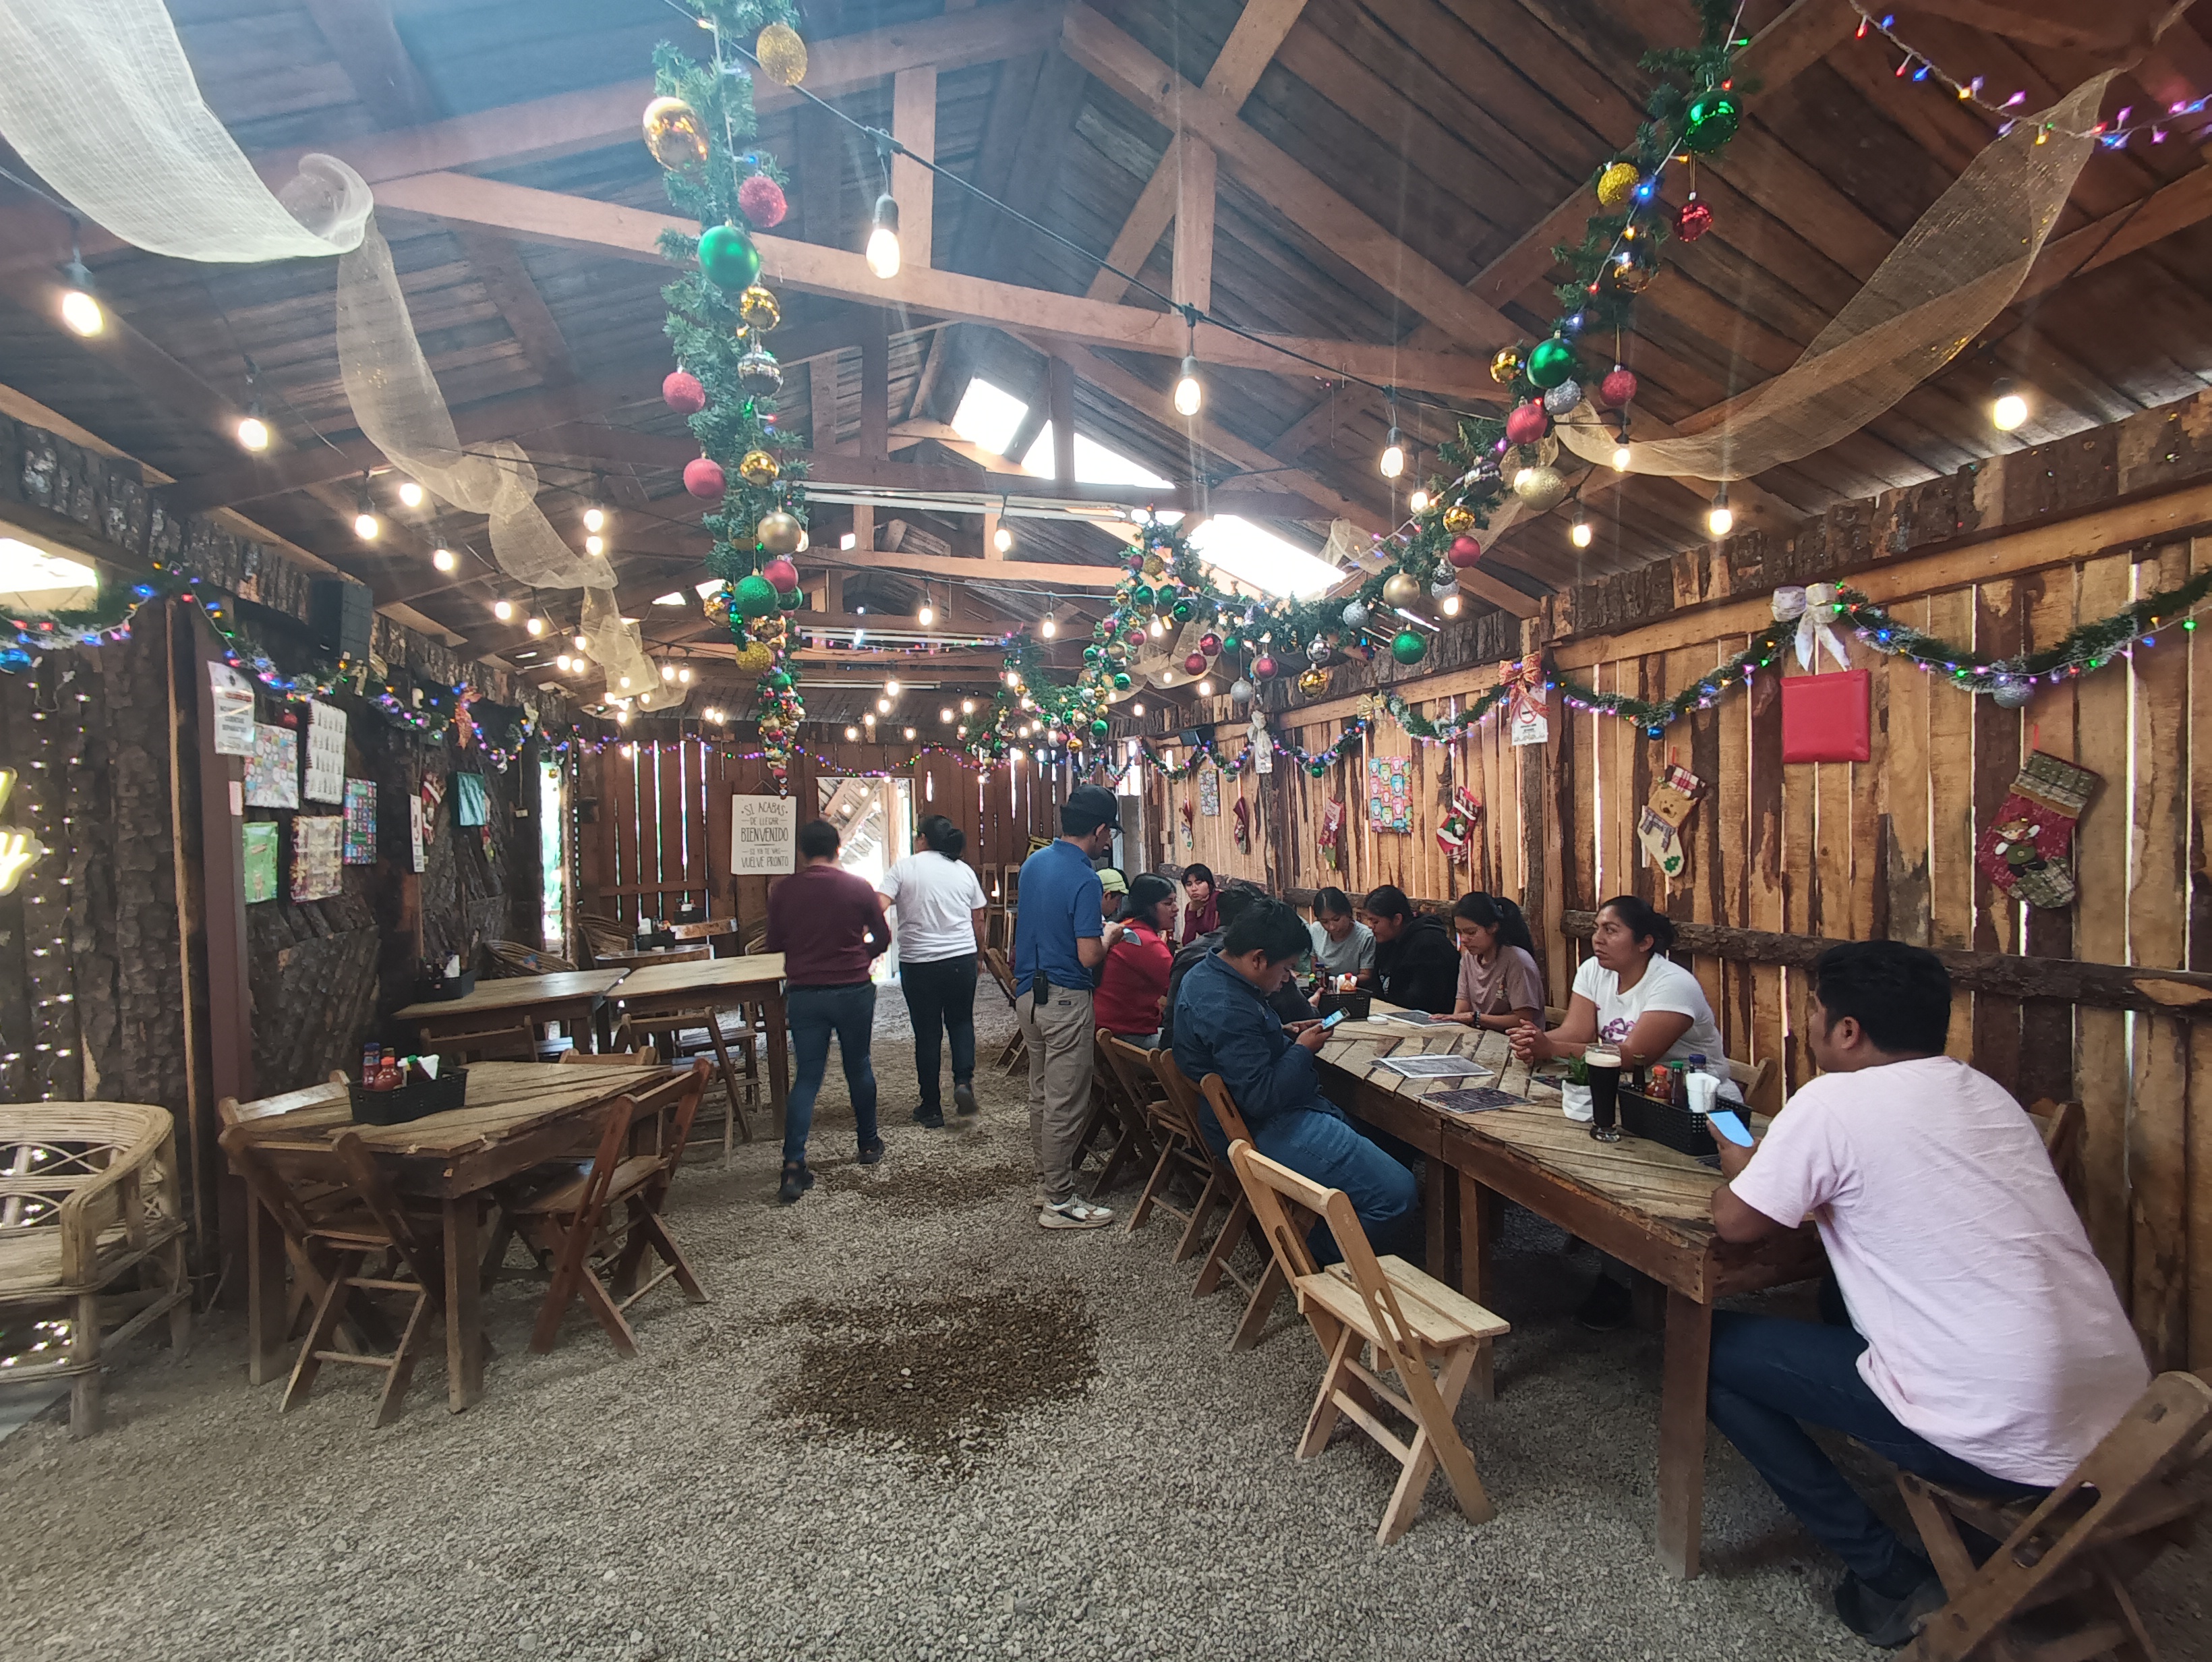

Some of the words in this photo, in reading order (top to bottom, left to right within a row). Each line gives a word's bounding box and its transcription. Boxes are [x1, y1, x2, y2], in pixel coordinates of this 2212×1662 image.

[744, 803, 755, 816] SI
[759, 801, 786, 816] ACABAS
[750, 817, 757, 826] DE
[759, 817, 779, 826] LLEGAR
[741, 827, 788, 842] BIENVENIDO
[741, 856, 765, 868] VUELVE
[767, 855, 788, 867] PRONTO
